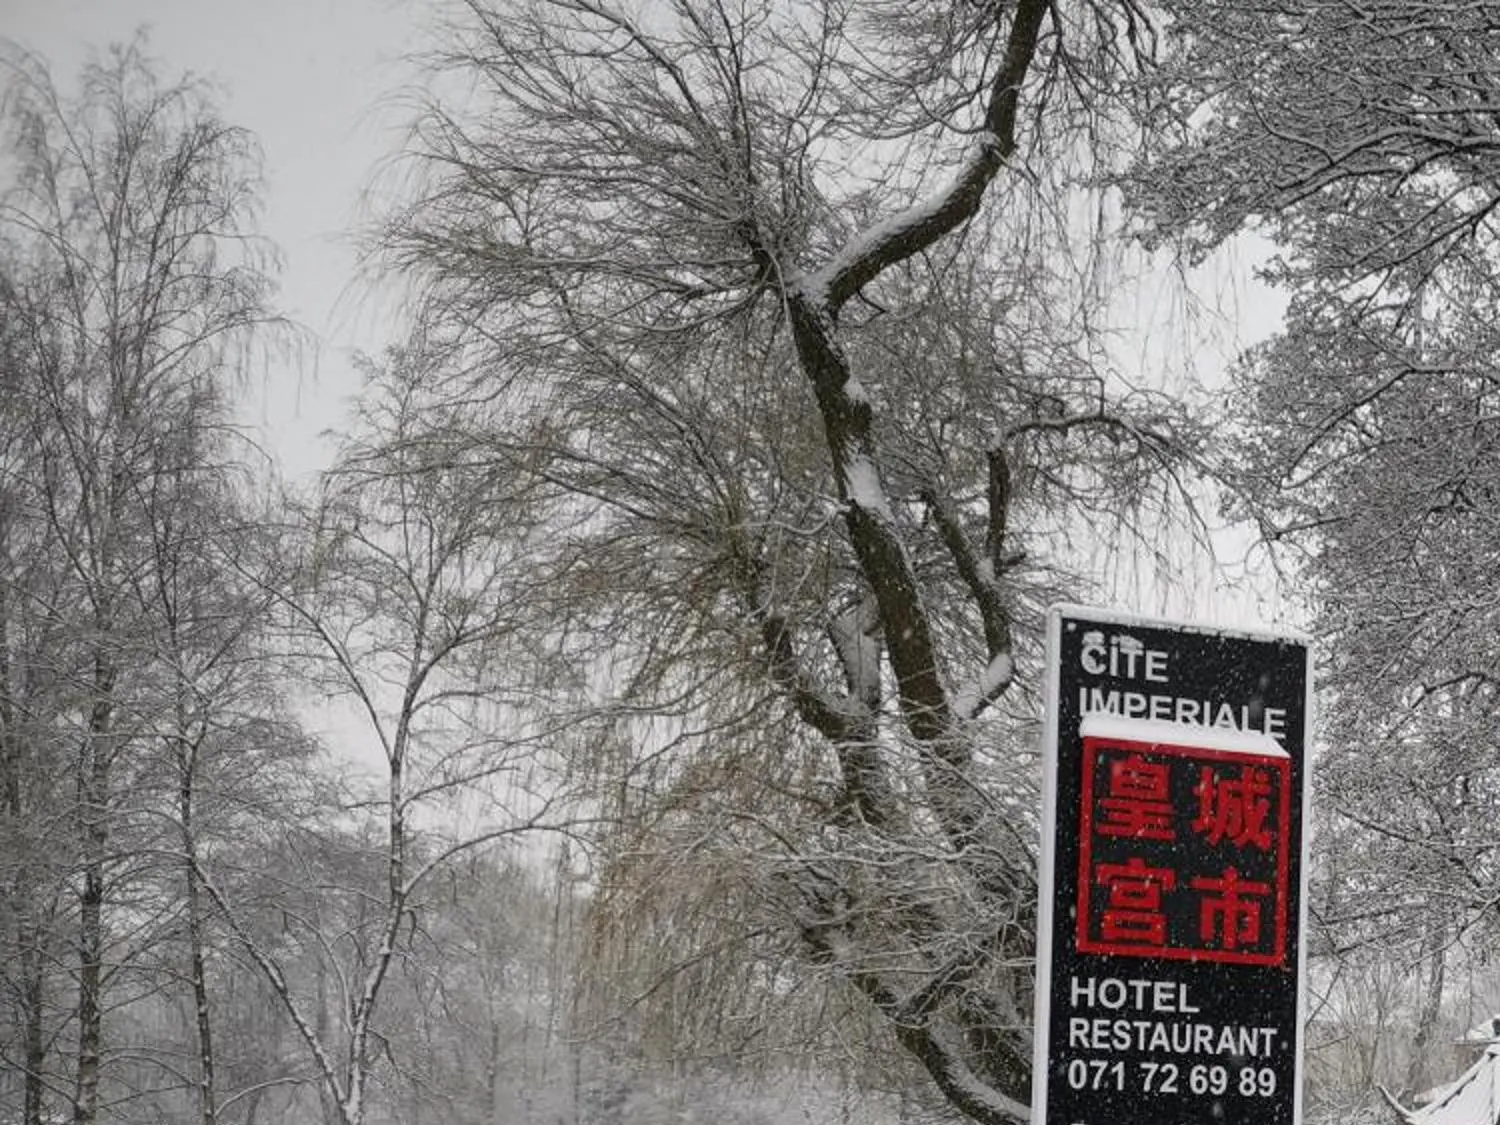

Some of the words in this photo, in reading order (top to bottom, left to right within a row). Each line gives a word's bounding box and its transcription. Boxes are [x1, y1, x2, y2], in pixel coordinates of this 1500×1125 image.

[1079, 687, 1287, 739] IMPERIALE
[1071, 977, 1200, 1013] HOTEL
[1069, 1018, 1277, 1056] RESTAURANT
[1067, 1060, 1126, 1091] 071
[1140, 1063, 1178, 1094] 72
[1189, 1066, 1228, 1095] 69
[1238, 1068, 1277, 1097] 89
